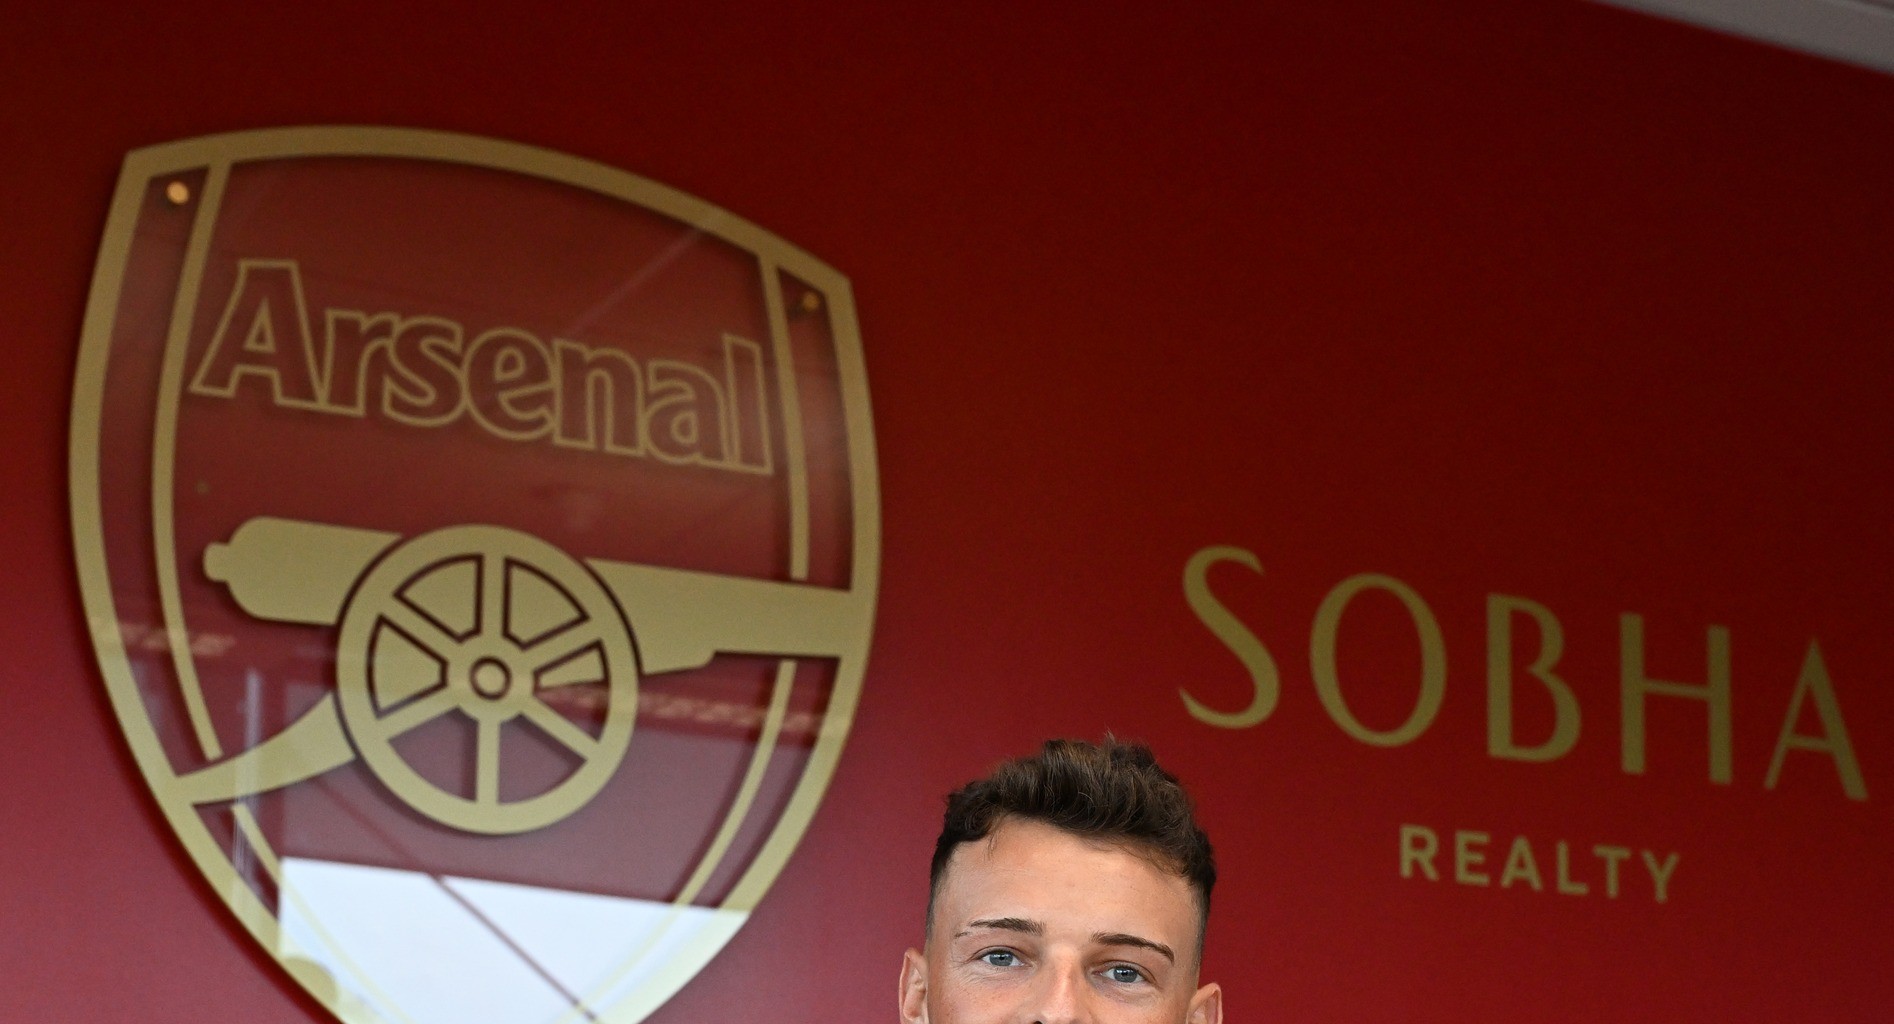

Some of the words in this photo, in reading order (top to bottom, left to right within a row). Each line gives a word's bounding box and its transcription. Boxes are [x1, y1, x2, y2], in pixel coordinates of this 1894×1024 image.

[189, 259, 774, 475] Arsenal
[1179, 545, 1868, 802] SOBHA
[1399, 824, 1680, 902] REALTY
